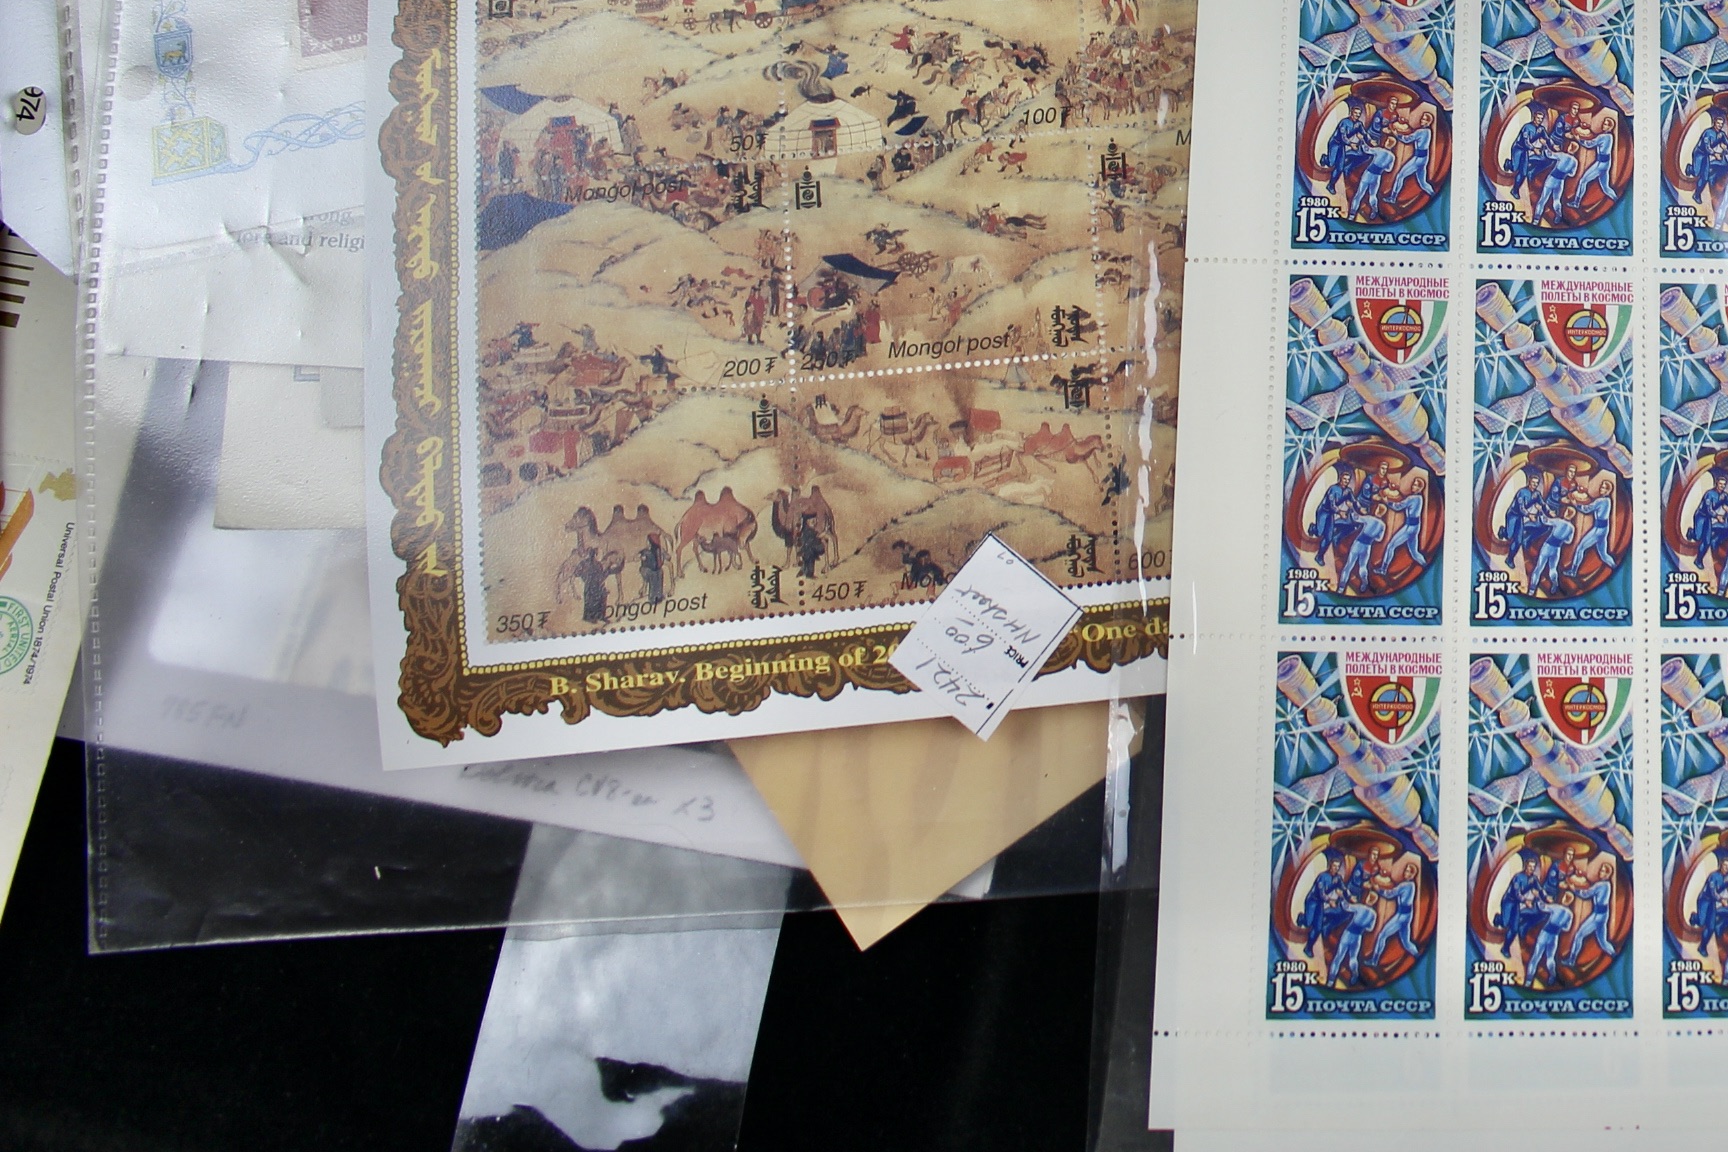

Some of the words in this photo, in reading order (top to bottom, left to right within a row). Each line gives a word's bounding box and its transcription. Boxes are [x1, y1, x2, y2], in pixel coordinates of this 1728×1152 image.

[565, 179, 639, 203] Mongol
[641, 176, 685, 199] post
[1300, 197, 1329, 207] 1980
[1667, 206, 1696, 216] 1980
[1328, 232, 1397, 245] ПОЧТА
[1398, 232, 1446, 246] СССР
[1541, 291, 1583, 303] ПОЛЕТЫ
[1591, 292, 1635, 304] КОСМОС
[55, 522, 76, 569] Universal
[46, 571, 62, 604] Postal
[36, 605, 54, 636] Union
[23, 636, 44, 686] 1874/1974
[550, 675, 578, 697] B.
[585, 667, 687, 695] Sharav.
[695, 652, 832, 684] Beginning
[838, 646, 867, 668] of
